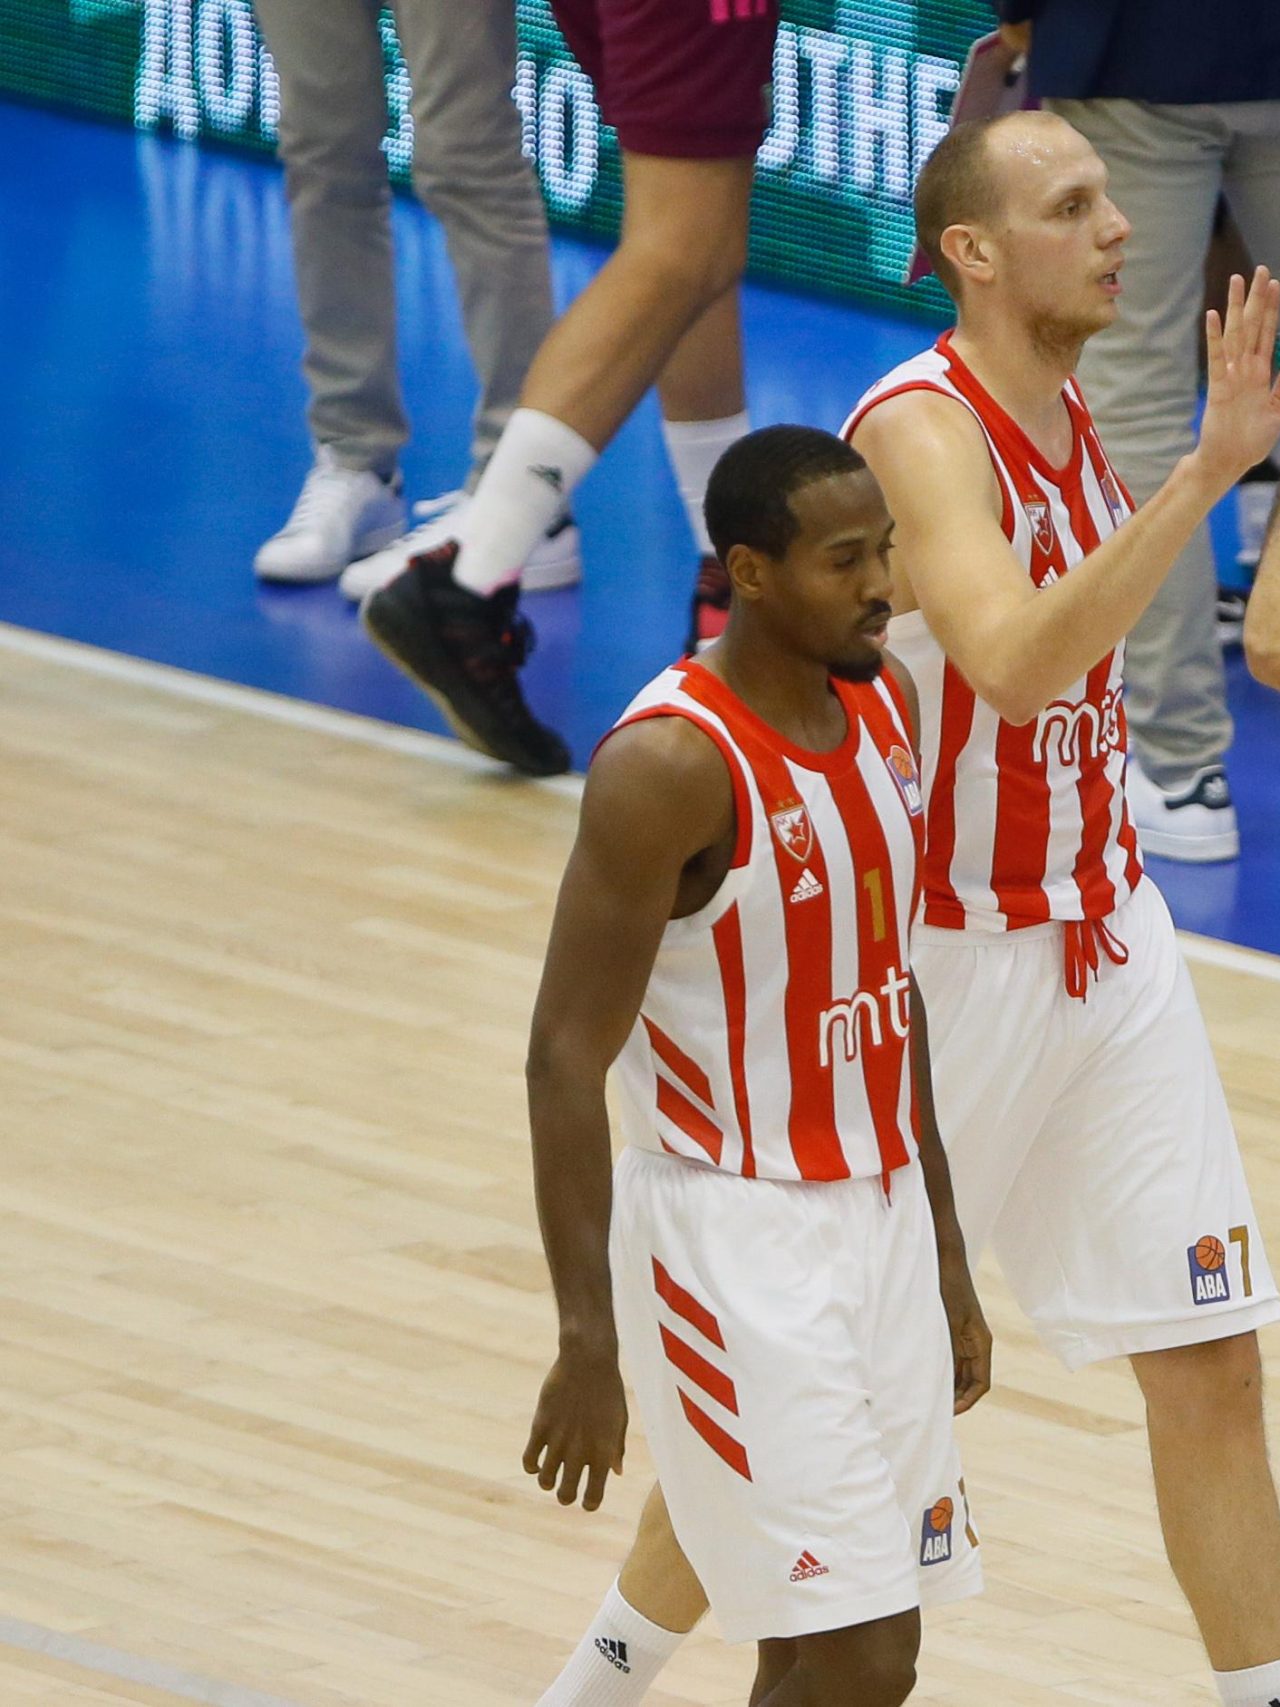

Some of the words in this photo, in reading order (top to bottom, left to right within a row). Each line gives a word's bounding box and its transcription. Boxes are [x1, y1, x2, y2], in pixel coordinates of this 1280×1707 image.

[863, 867, 886, 942] 1
[1228, 1224, 1253, 1297] 7
[1196, 1272, 1227, 1301] ABA
[922, 1533, 949, 1562] ABA
[789, 1565, 829, 1582] adidas
[594, 1637, 631, 1674] adidas
